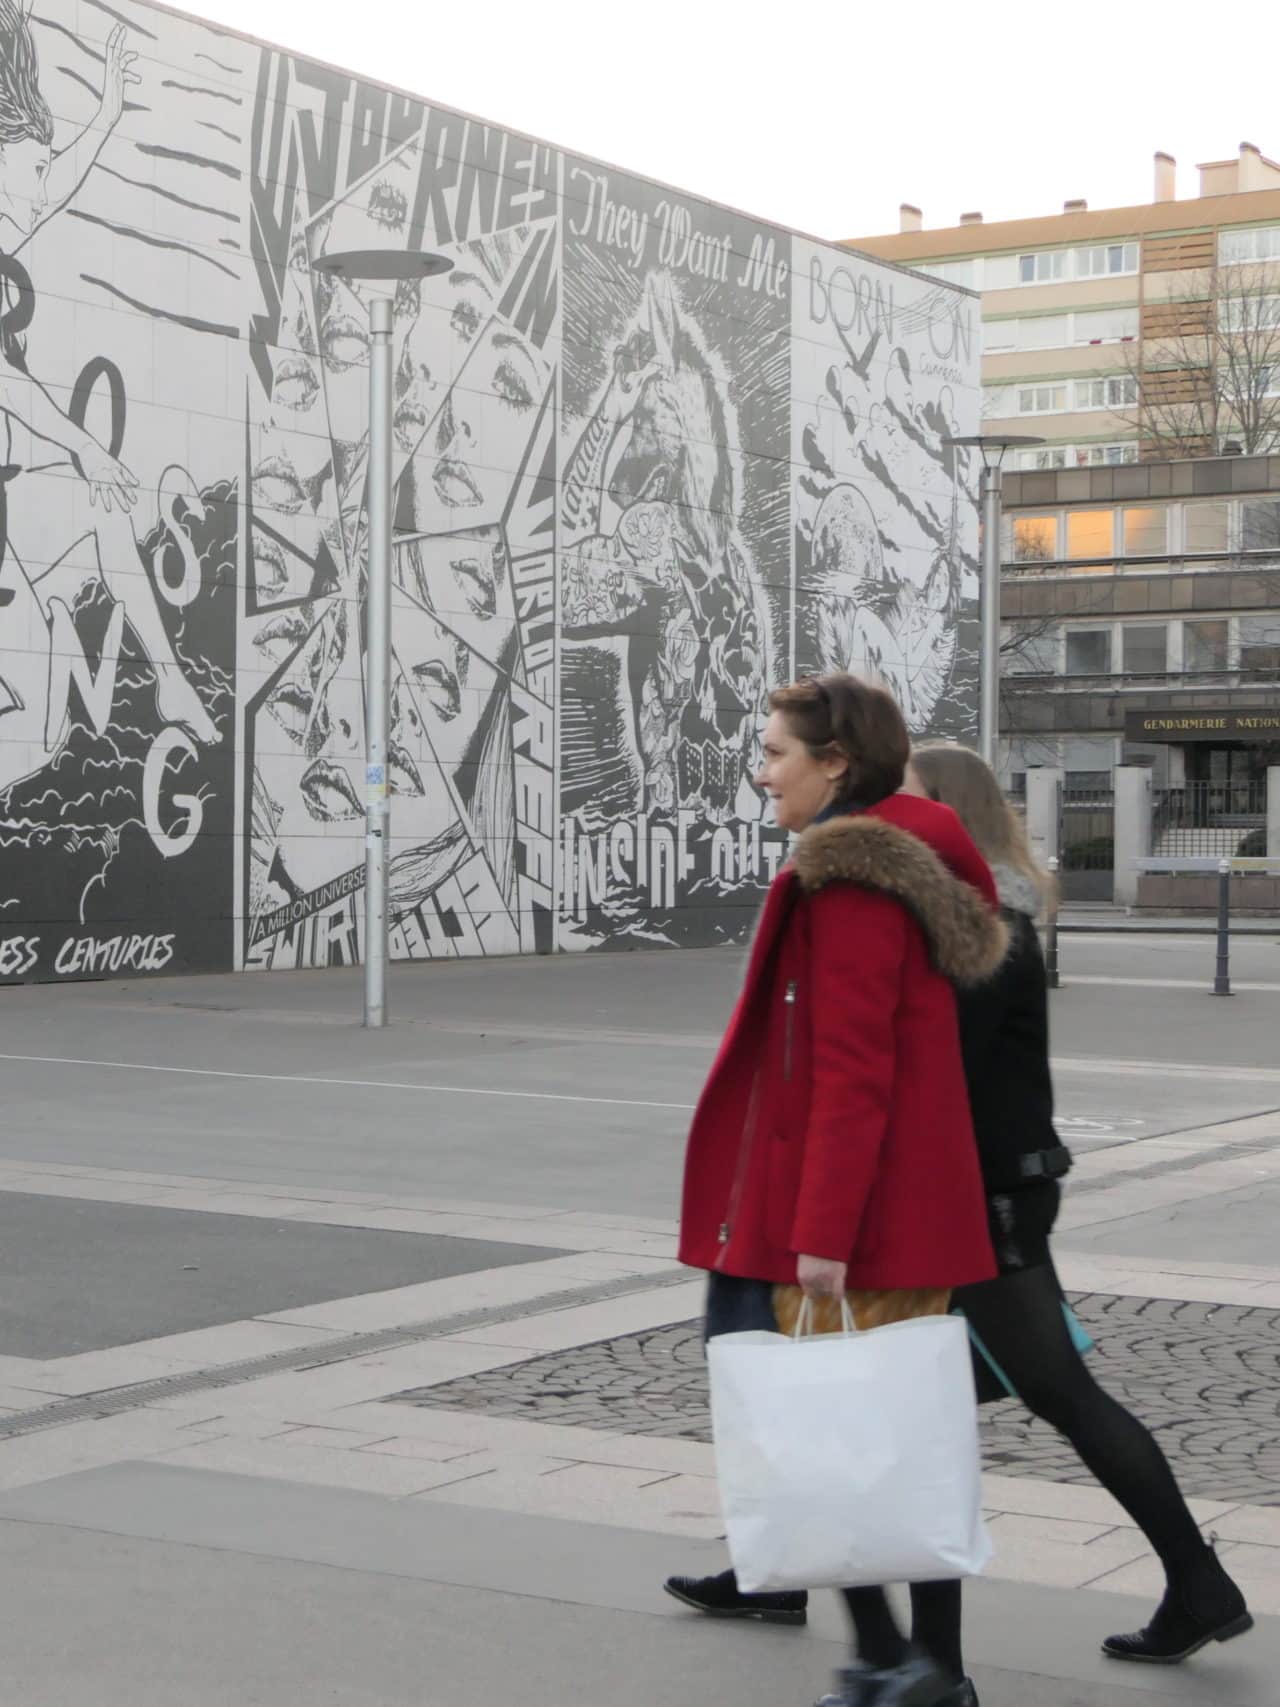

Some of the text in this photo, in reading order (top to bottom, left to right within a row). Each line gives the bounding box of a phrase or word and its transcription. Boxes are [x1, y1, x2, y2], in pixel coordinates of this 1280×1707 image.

[570, 167, 788, 299] They Want Me
[810, 255, 972, 365] BORN ON
[1143, 718, 1228, 731] GENDARMERIE
[267, 895, 313, 930] MILLION
[55, 934, 176, 973] CENTURIES
